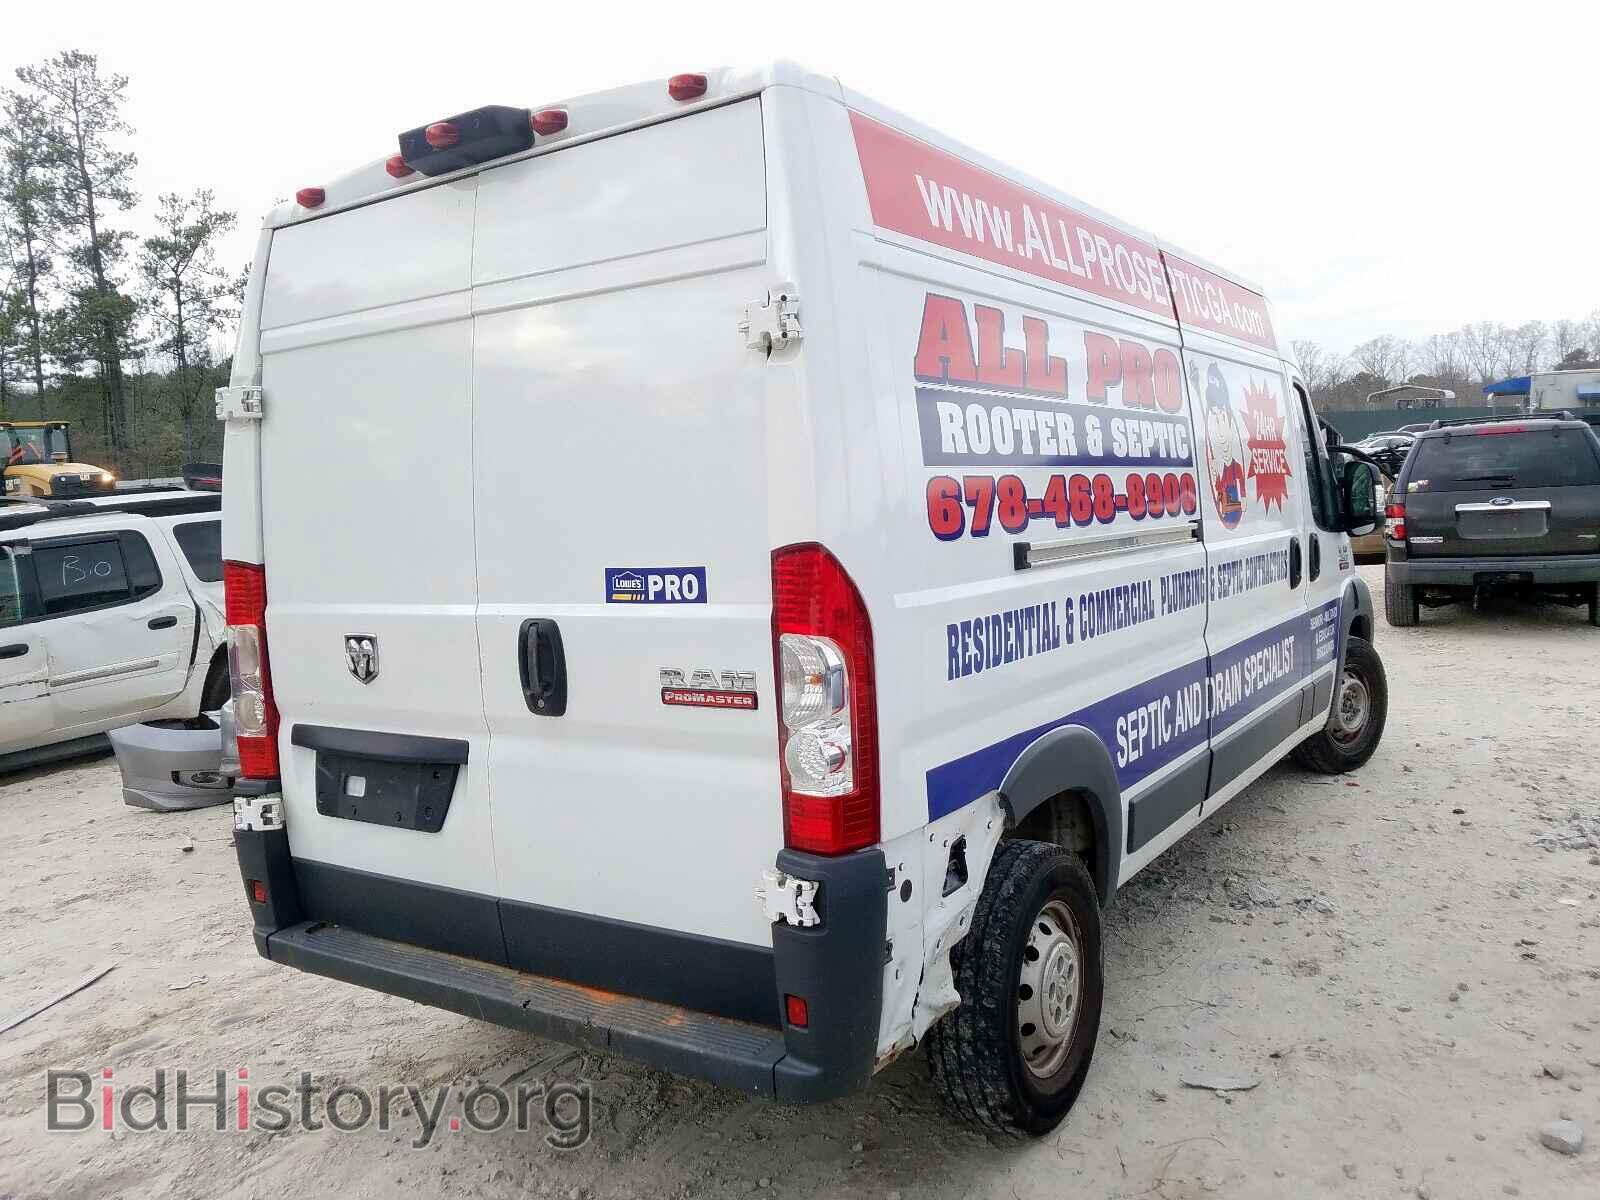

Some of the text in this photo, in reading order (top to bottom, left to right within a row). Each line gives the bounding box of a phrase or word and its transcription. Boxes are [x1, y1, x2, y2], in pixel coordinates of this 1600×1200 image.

[914, 291, 1183, 413] ALL PRO
[936, 401, 1189, 459] ROOTER & SEPTIC
[1252, 448, 1286, 474] SERVICE
[925, 472, 1197, 541] 678-468-8900
[615, 573, 699, 601] LOWE'S PRO
[946, 601, 1060, 681] RESIDENTIAL
[1065, 597, 1074, 645] &
[1079, 579, 1155, 641] COMMERCIAL
[1160, 567, 1206, 617] PLUMBING
[1210, 565, 1215, 602] &
[1218, 559, 1243, 600] SEPTIC
[1245, 549, 1288, 591] CONTRACTORS
[660, 667, 757, 690] RAM
[664, 691, 752, 705] PROMASTER
[1116, 635, 1295, 769] SEPTIC AND DRAIN SPECIALIST
